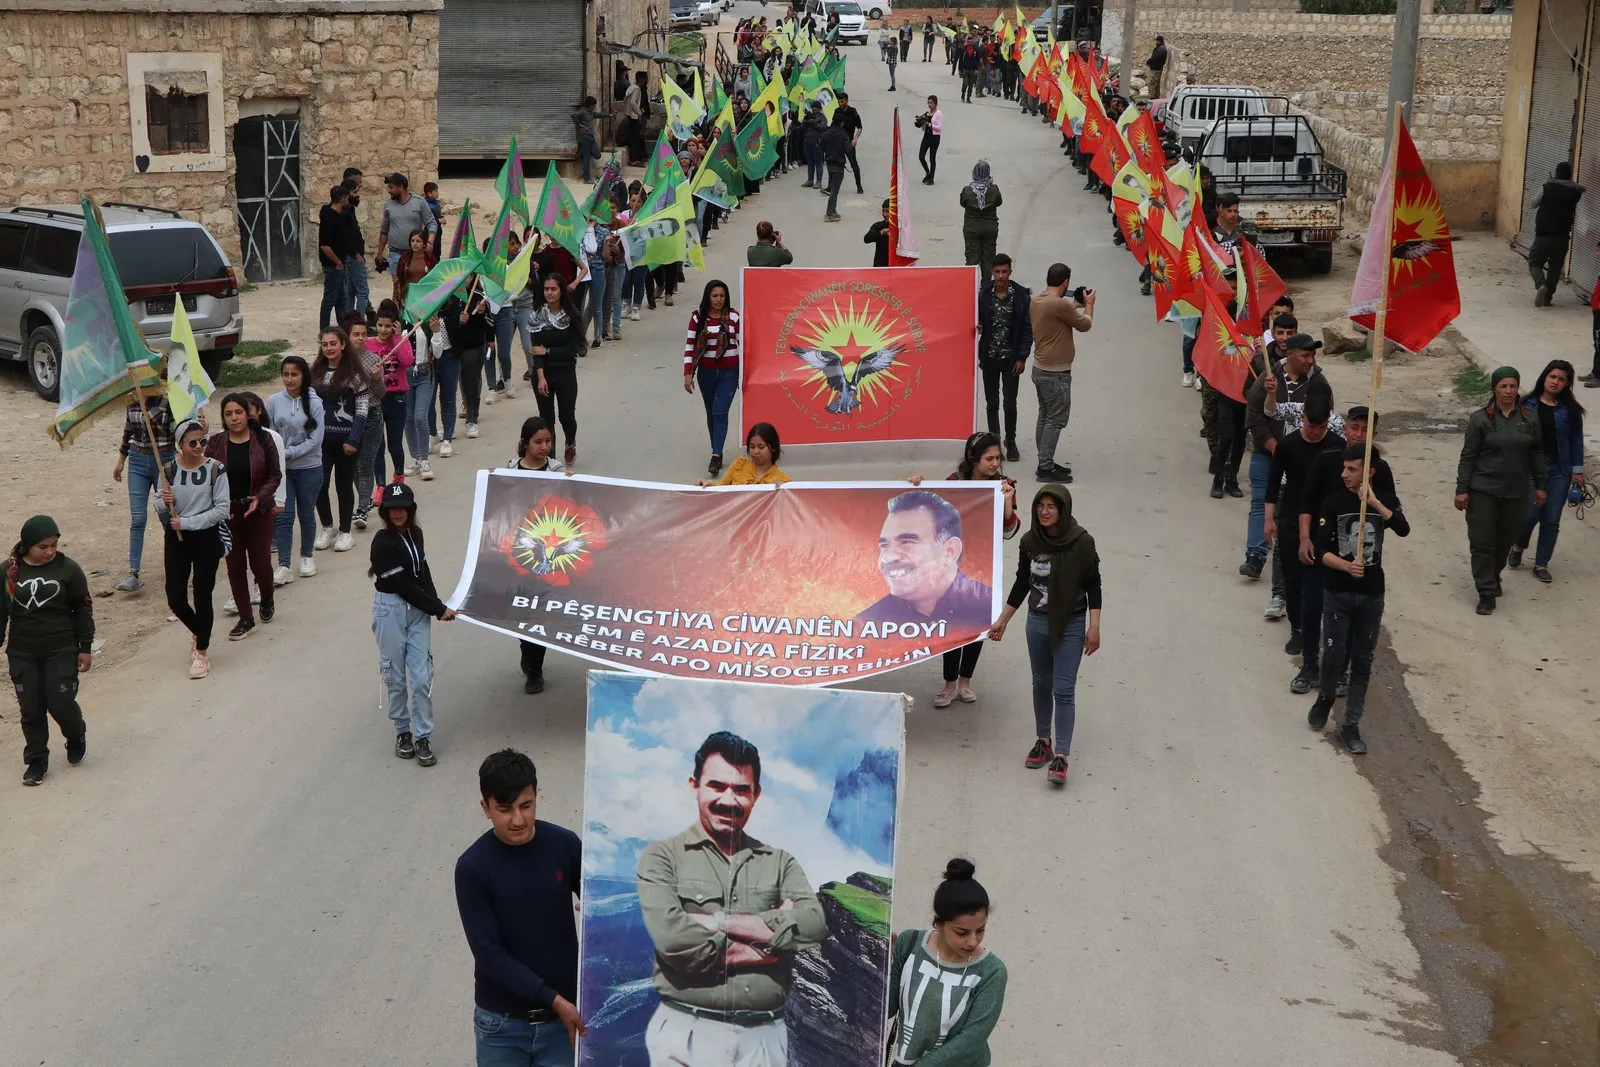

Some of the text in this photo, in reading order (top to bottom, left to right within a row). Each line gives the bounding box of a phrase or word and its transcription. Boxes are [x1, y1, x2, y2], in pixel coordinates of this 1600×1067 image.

[776, 308, 802, 356] TEVGERA
[392, 485, 403, 496] LA
[581, 623, 622, 640] EM
[629, 629, 646, 643] Ê
[652, 634, 778, 659] AZADİYA
[721, 611, 853, 638] CİWANÊN
[859, 619, 948, 639] APOYÎ
[555, 632, 644, 660] RÊBER
[650, 652, 711, 672] APO
